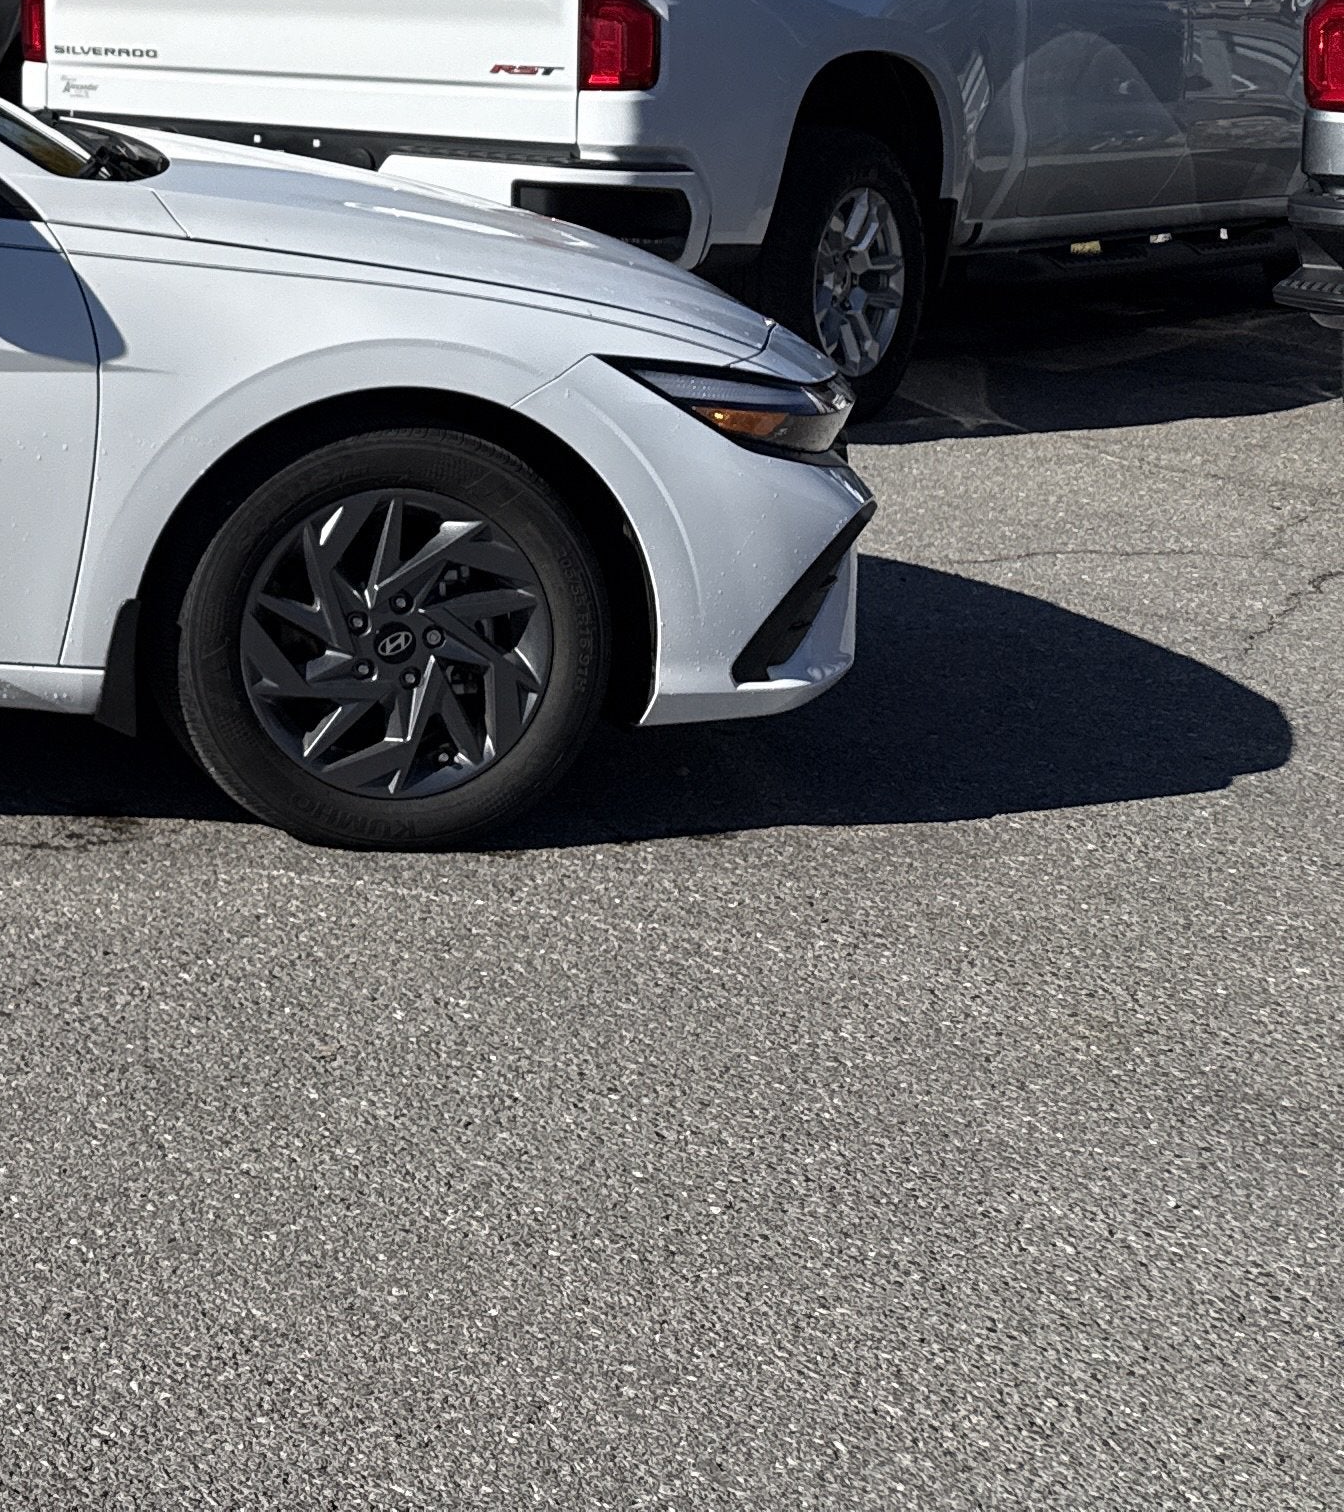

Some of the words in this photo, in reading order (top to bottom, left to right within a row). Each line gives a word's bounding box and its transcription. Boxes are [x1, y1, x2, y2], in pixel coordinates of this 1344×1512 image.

[54, 45, 158, 58] SILVERADO
[490, 64, 565, 76] RST
[288, 790, 416, 837] KUMHO
